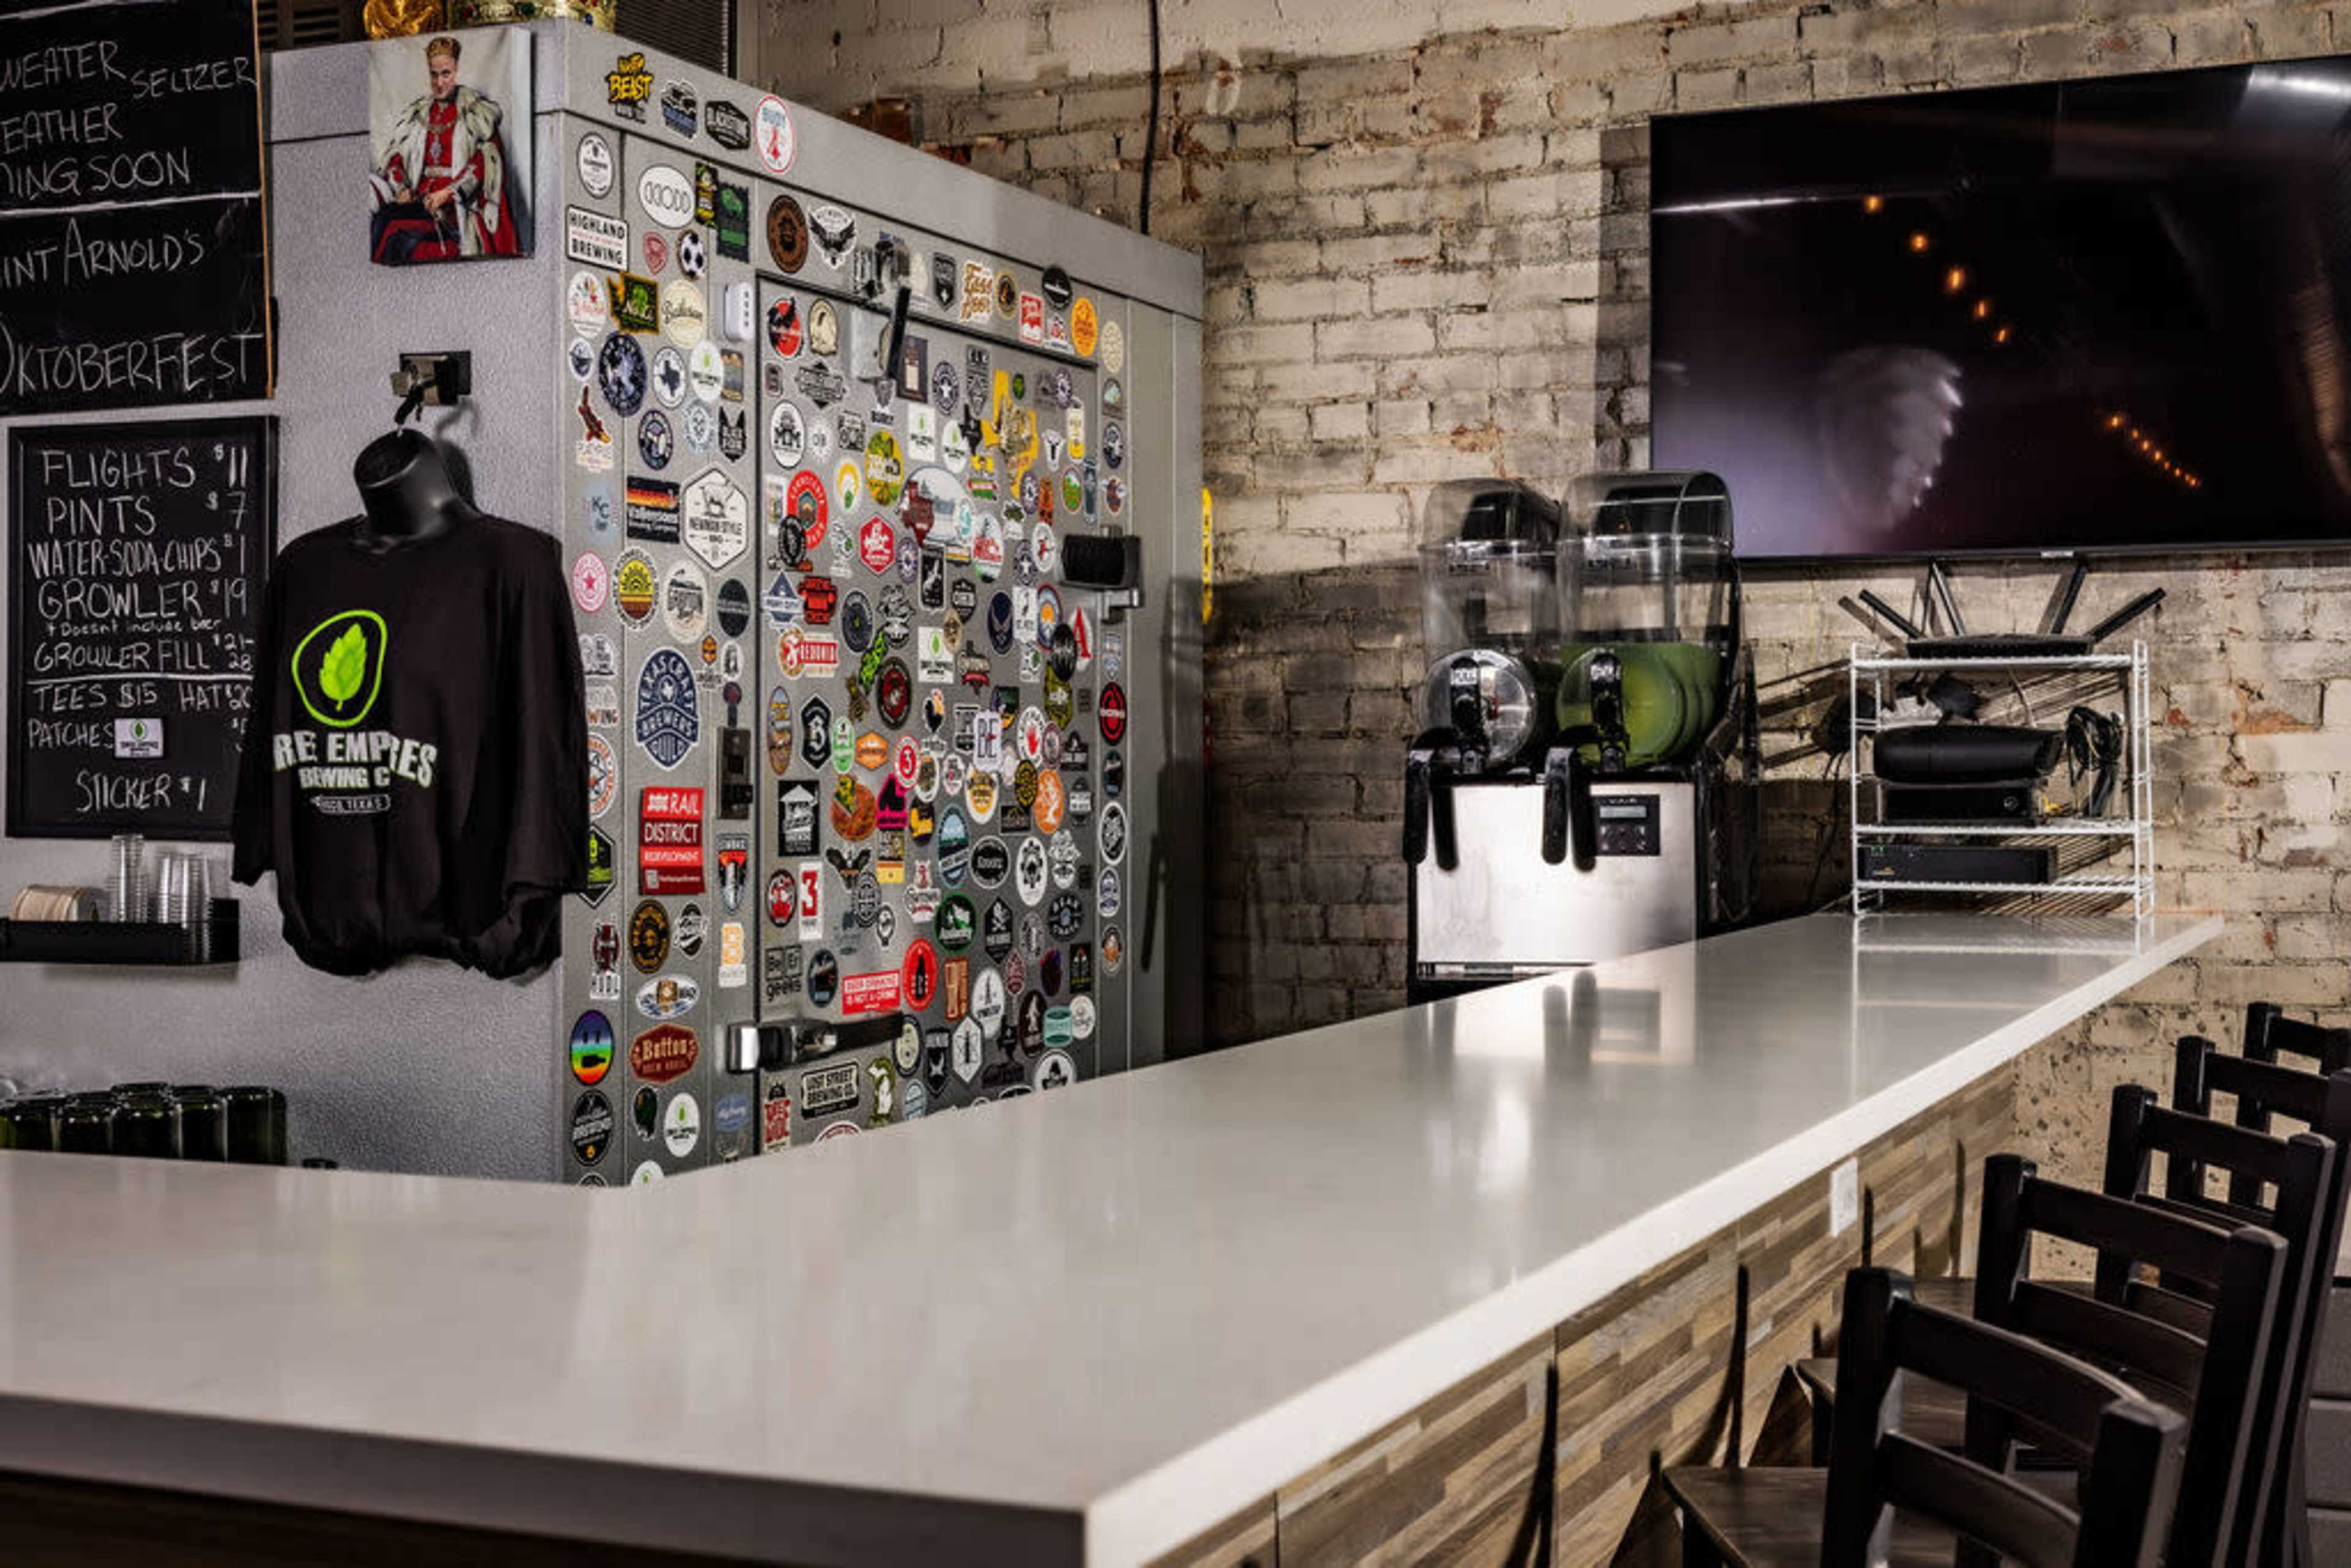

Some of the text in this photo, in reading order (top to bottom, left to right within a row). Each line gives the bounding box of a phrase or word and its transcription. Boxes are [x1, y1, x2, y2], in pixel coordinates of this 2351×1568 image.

[130, 56, 258, 99] SELTZER
[608, 74, 653, 101] BEAST
[88, 148, 190, 192] SOON
[569, 211, 625, 239] HIGHLAND
[64, 217, 204, 285] ARNOLD'S
[572, 239, 623, 266] BREWING
[42, 445, 247, 489] FLIGHTS $11
[47, 491, 247, 535] PINTS $7
[592, 497, 610, 519] KC
[39, 578, 246, 620] GROWLER $19
[34, 642, 151, 671] GROWLER
[158, 639, 210, 671] FILL
[228, 653, 253, 671] 28
[33, 683, 107, 711] TEES
[119, 681, 157, 708] $15
[179, 682, 221, 712] HAT
[640, 656, 694, 708] TEXAS CRAFT
[29, 718, 114, 749] PATCHES
[642, 708, 692, 735] BREWERS
[651, 734, 685, 763] GUILD
[76, 769, 206, 812] STICKER $1
[670, 792, 699, 815] RAIL
[644, 823, 699, 843] DISTRICT
[801, 870, 817, 917] 3
[767, 978, 801, 1002] geeks
[827, 1069, 853, 1086] STREET
[807, 1088, 843, 1106] BREWING
